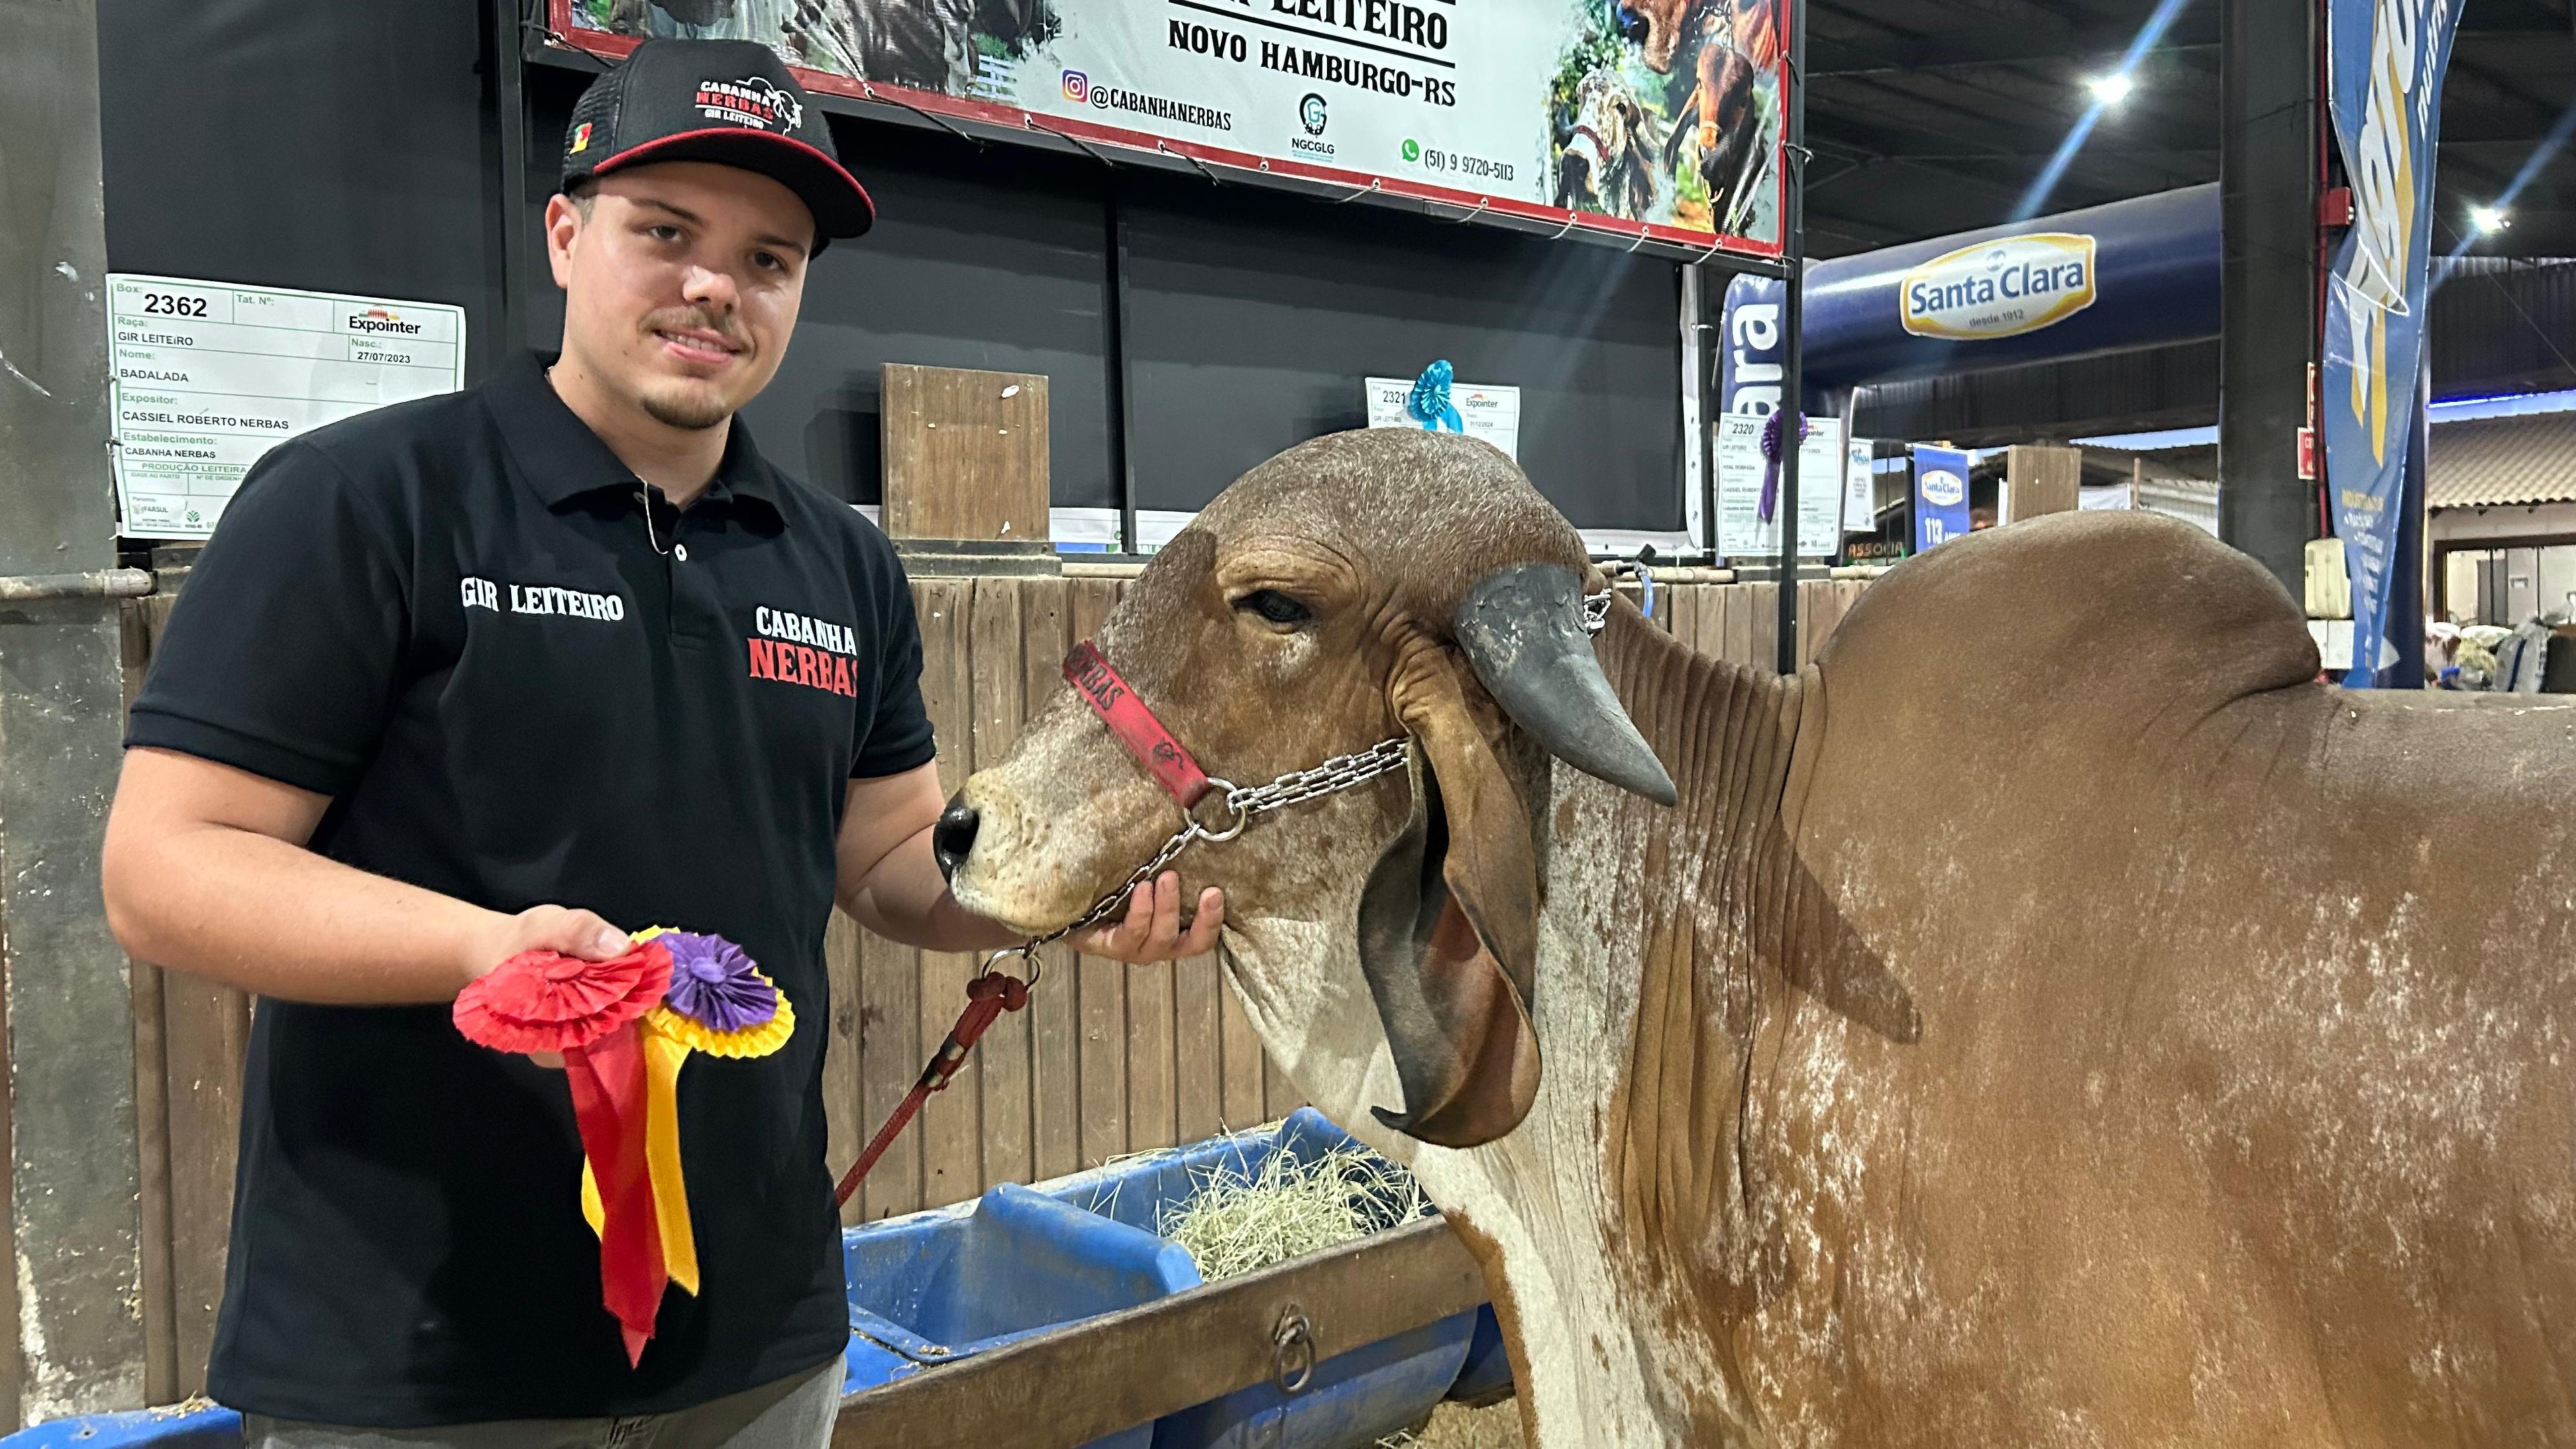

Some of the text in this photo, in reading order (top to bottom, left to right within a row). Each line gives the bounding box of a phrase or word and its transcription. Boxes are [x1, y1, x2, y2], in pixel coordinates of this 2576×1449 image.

[1168, 19, 1456, 107] NOVO HAMBURGO-RS
[700, 81, 771, 106] CABANHA
[696, 91, 773, 119] NERBAS
[1090, 85, 1231, 131] @CABANHANERBAS
[704, 109, 764, 129] GIR LEITEIRO
[1292, 138, 1334, 154] NGCGLG
[1425, 148, 1514, 181] (51) 9 9720-5113
[1911, 262, 2084, 315] Santa Clara
[117, 283, 207, 317] Box: 2362
[236, 294, 255, 304] Tat.
[117, 317, 148, 327] Raça:
[349, 316, 421, 334] Expointer
[1970, 309, 2023, 328] desde 1912
[118, 331, 138, 341] GIR
[119, 349, 155, 360] Nome:
[357, 352, 411, 364] 27/07/2023
[120, 368, 189, 382] BADALADA
[121, 392, 178, 405] Expositor:
[1383, 390, 1405, 404] 2321
[1466, 397, 1497, 409] Expointer
[122, 411, 289, 429] CASSIEL ROBERTO NERBAS
[1732, 424, 1754, 435] 2320
[123, 432, 217, 445] Estabelecimento:
[125, 447, 216, 458] CABANHA NERBAS
[142, 463, 247, 474] PRODUÇÃO LEITEIRA
[1925, 481, 1960, 494] Santa Clara
[1925, 517, 1943, 544] 113
[461, 577, 624, 621] GIR LEITEIRO
[755, 606, 857, 655] CABANHA
